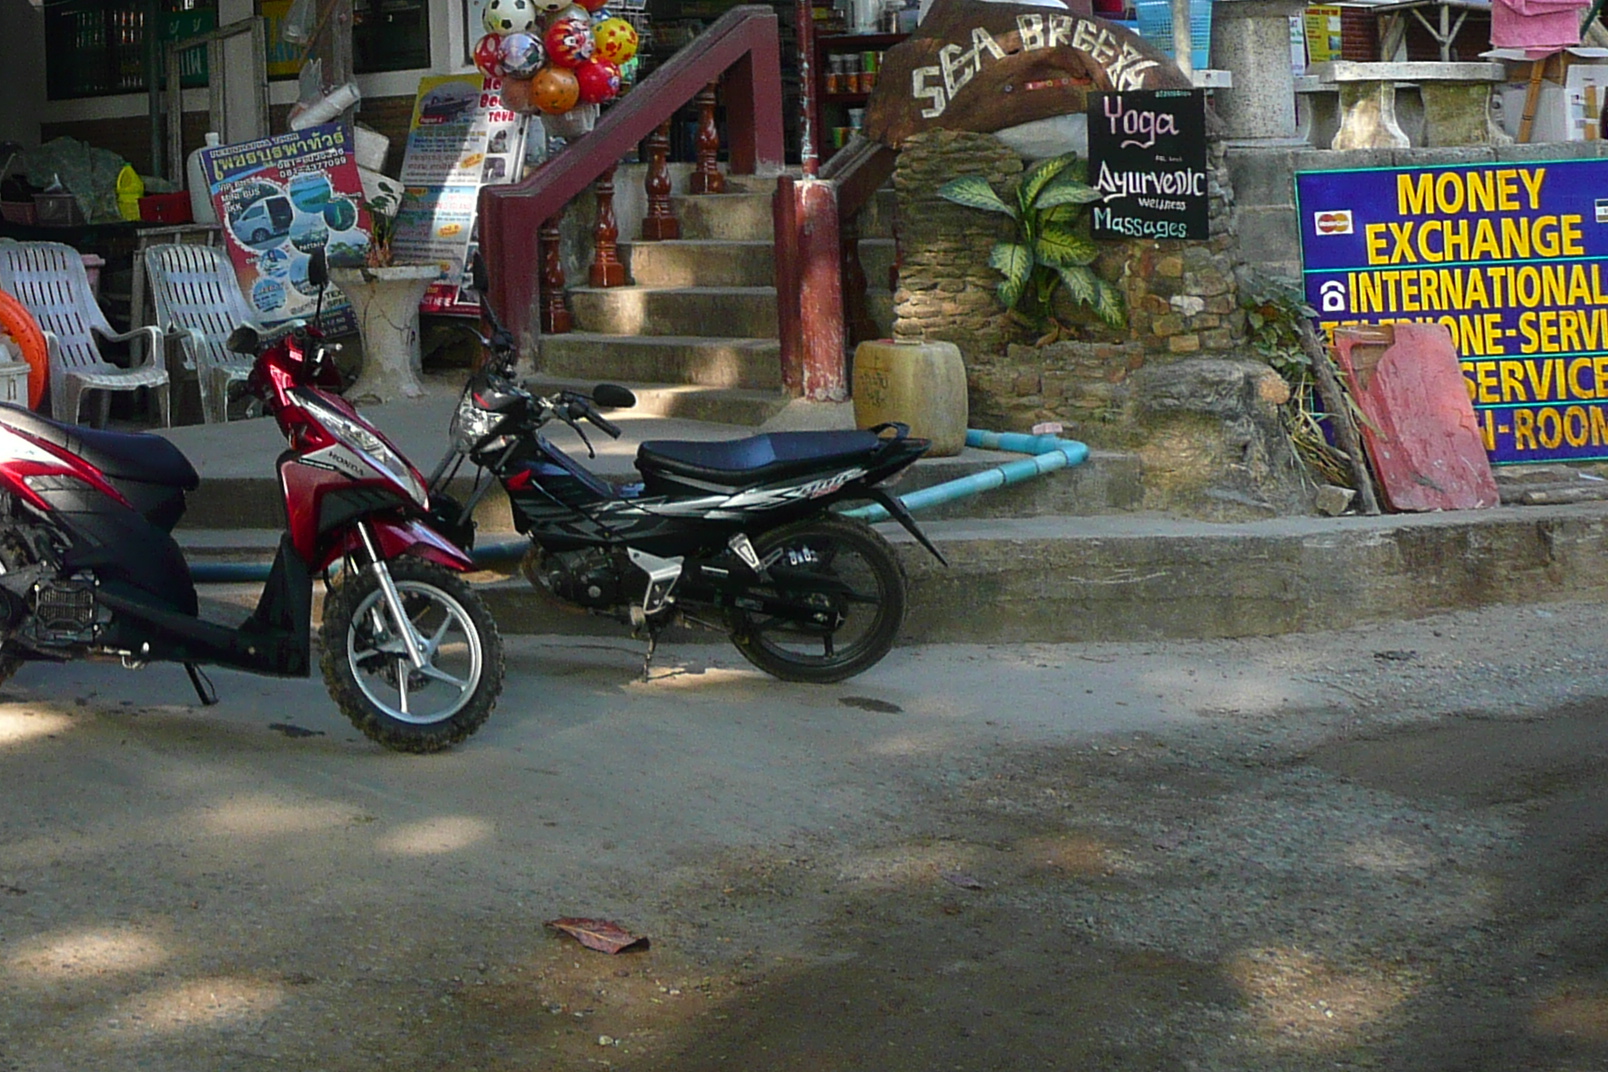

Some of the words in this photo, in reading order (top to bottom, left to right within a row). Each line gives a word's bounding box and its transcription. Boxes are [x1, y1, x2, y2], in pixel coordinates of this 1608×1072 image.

[911, 26, 1008, 119] SEA
[1103, 95, 1180, 149] Yoga
[1396, 168, 1546, 216] MONEY
[1094, 207, 1188, 239] Massages
[1365, 214, 1585, 266] EXCHANGE
[1348, 263, 1608, 314] INTERNATIONAL
[328, 450, 364, 476] HONDA
